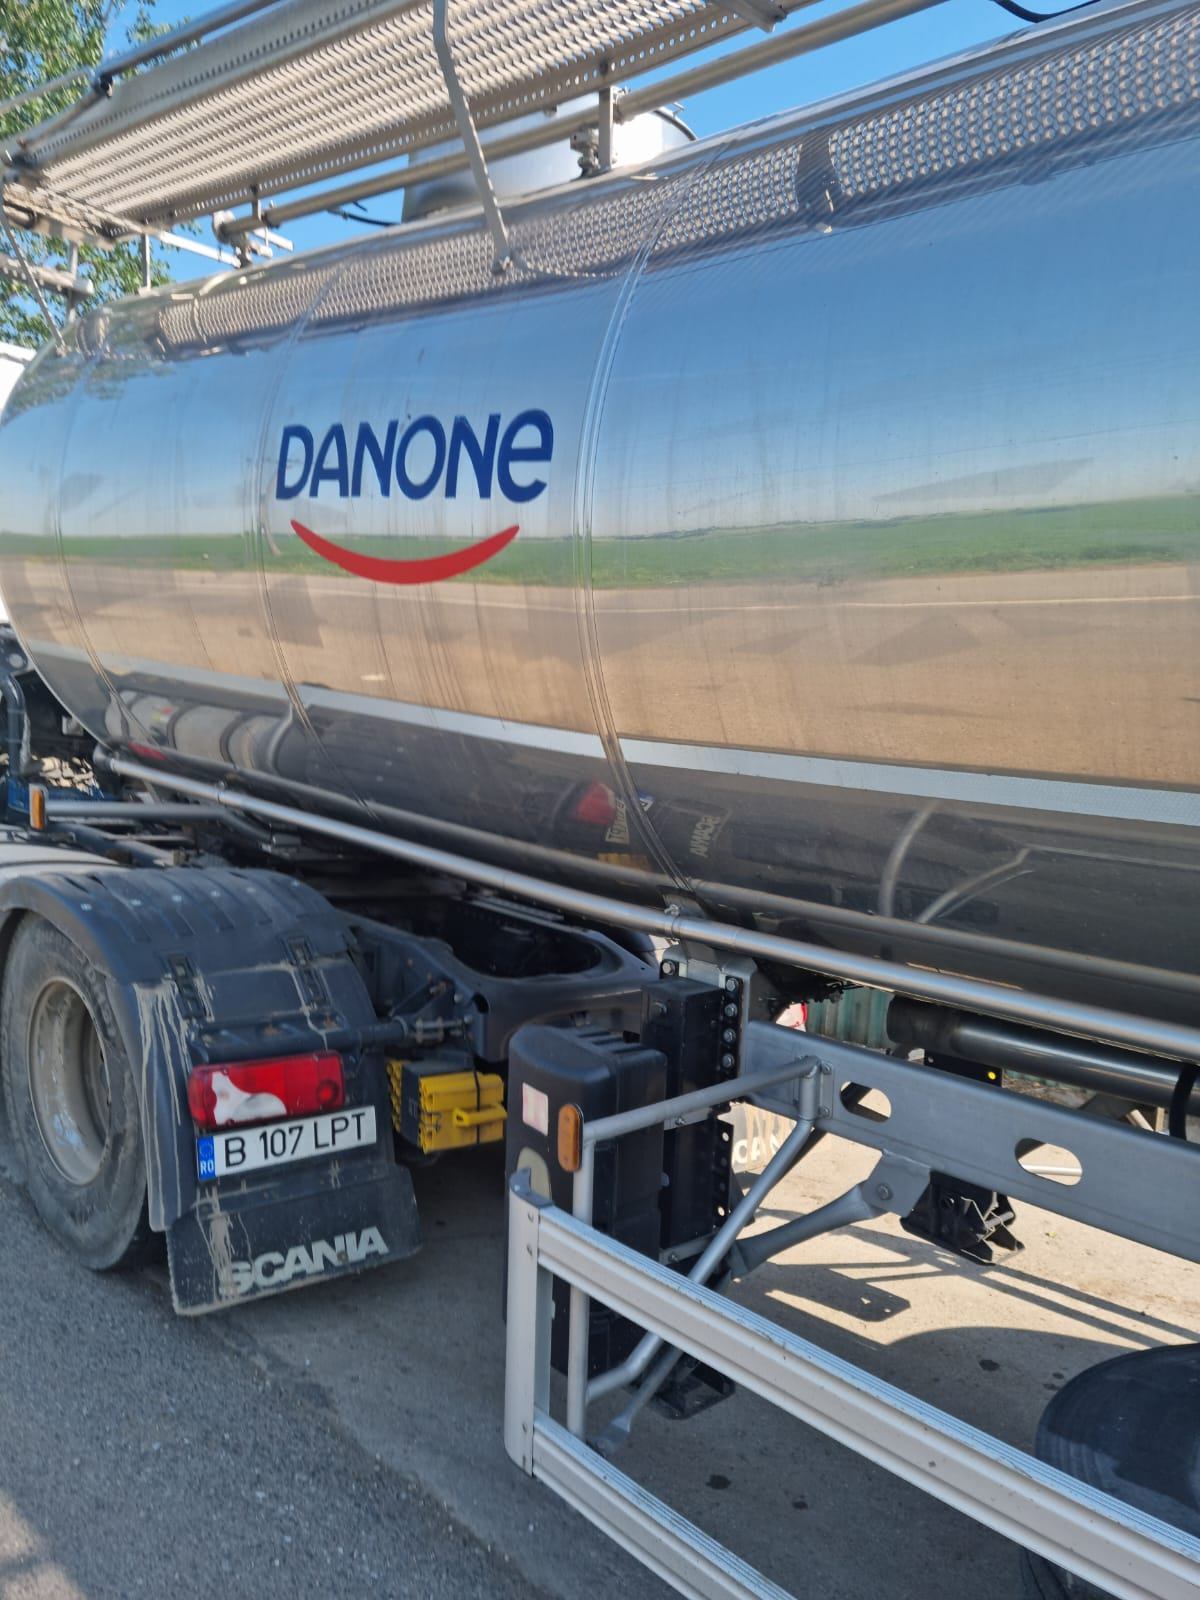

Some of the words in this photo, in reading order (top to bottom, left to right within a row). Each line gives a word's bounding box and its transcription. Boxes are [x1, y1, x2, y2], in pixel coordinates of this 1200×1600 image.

[200, 1160, 214, 1175] RO
[224, 1137, 247, 1168] B
[259, 1126, 303, 1161] 107
[313, 1112, 366, 1149] LPT
[219, 1226, 389, 1297] SCANIA
